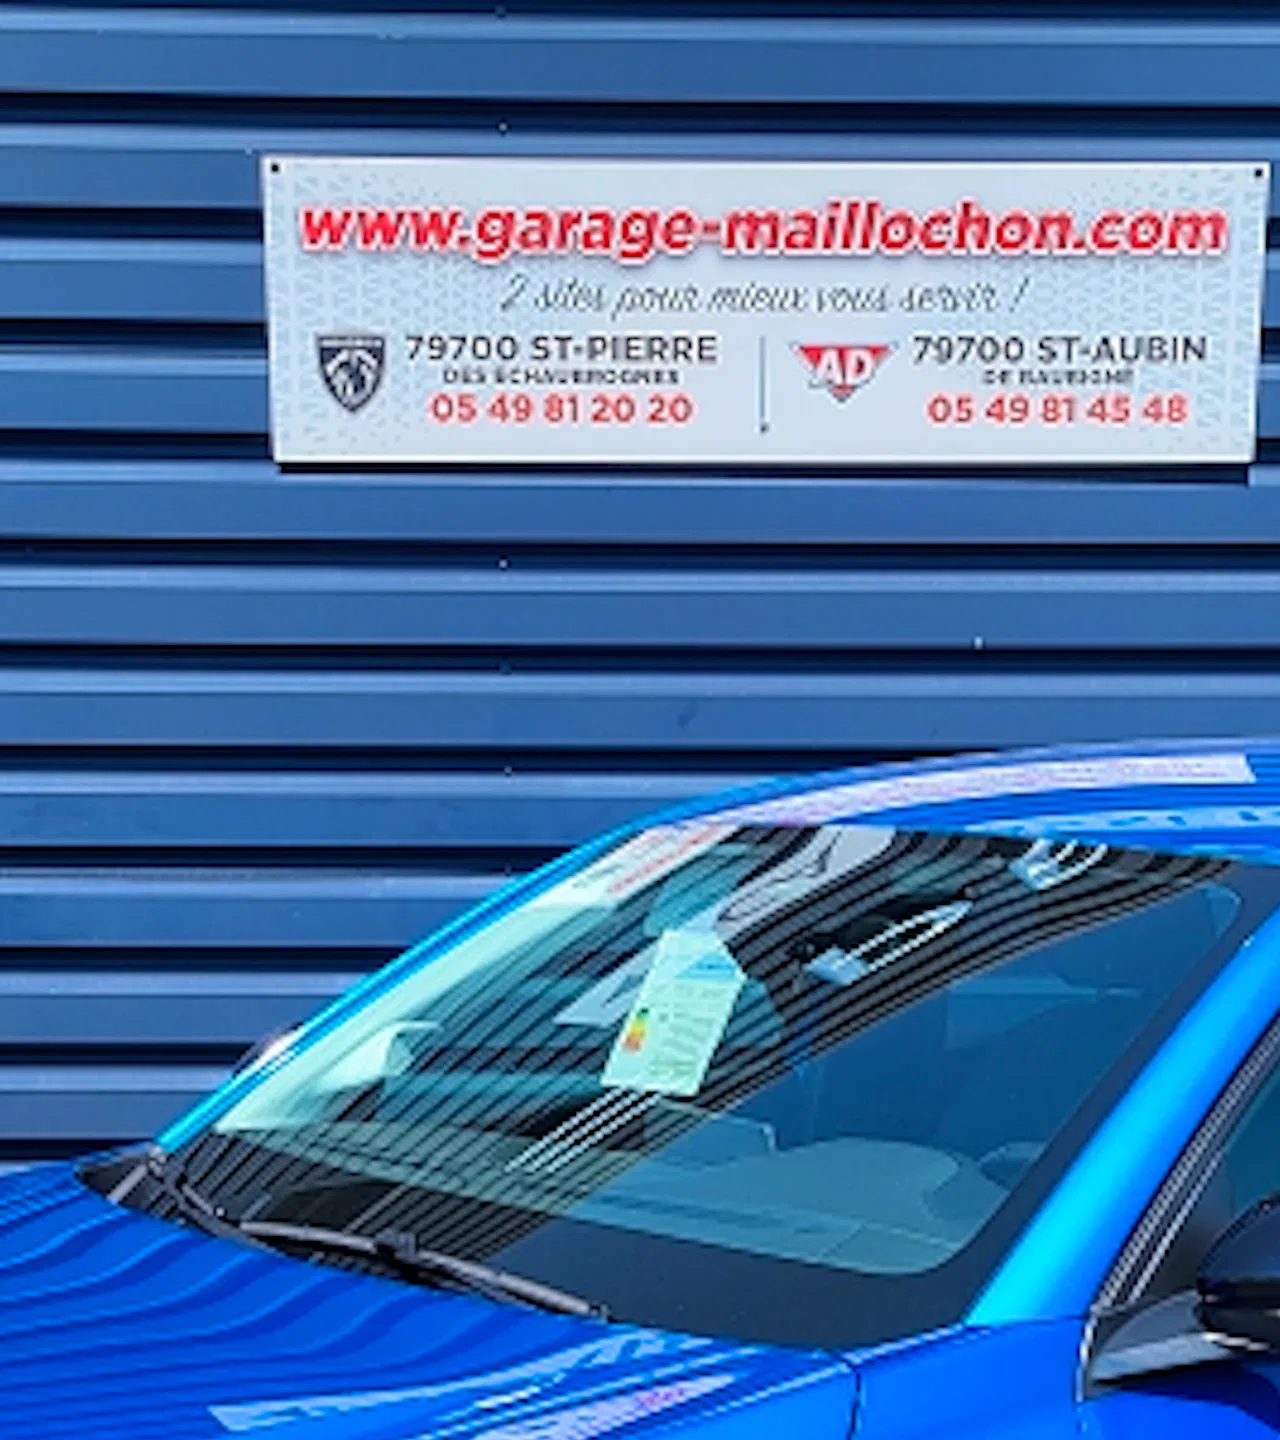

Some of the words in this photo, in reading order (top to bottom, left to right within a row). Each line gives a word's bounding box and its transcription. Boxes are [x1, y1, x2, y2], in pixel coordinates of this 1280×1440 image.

[299, 199, 1228, 263] www.garage-maillochon.com
[500, 273, 530, 310] 2
[610, 284, 700, 320] pour
[705, 280, 810, 312] mieux
[815, 284, 889, 312] vous
[404, 336, 518, 362] 79700
[529, 336, 717, 362] ST-PIERRE
[912, 335, 1026, 364] 79700
[1035, 335, 1207, 364] ST-AUBIN
[816, 348, 876, 386] AD
[431, 394, 479, 424] 05
[486, 394, 533, 424] 49
[543, 394, 580, 424] 81
[589, 394, 638, 424] 20
[647, 394, 696, 424] 20
[927, 394, 974, 424] 05
[984, 394, 1031, 424] 49
[1039, 394, 1076, 424] 81
[1086, 394, 1130, 424] 45
[1142, 394, 1189, 424] 48
